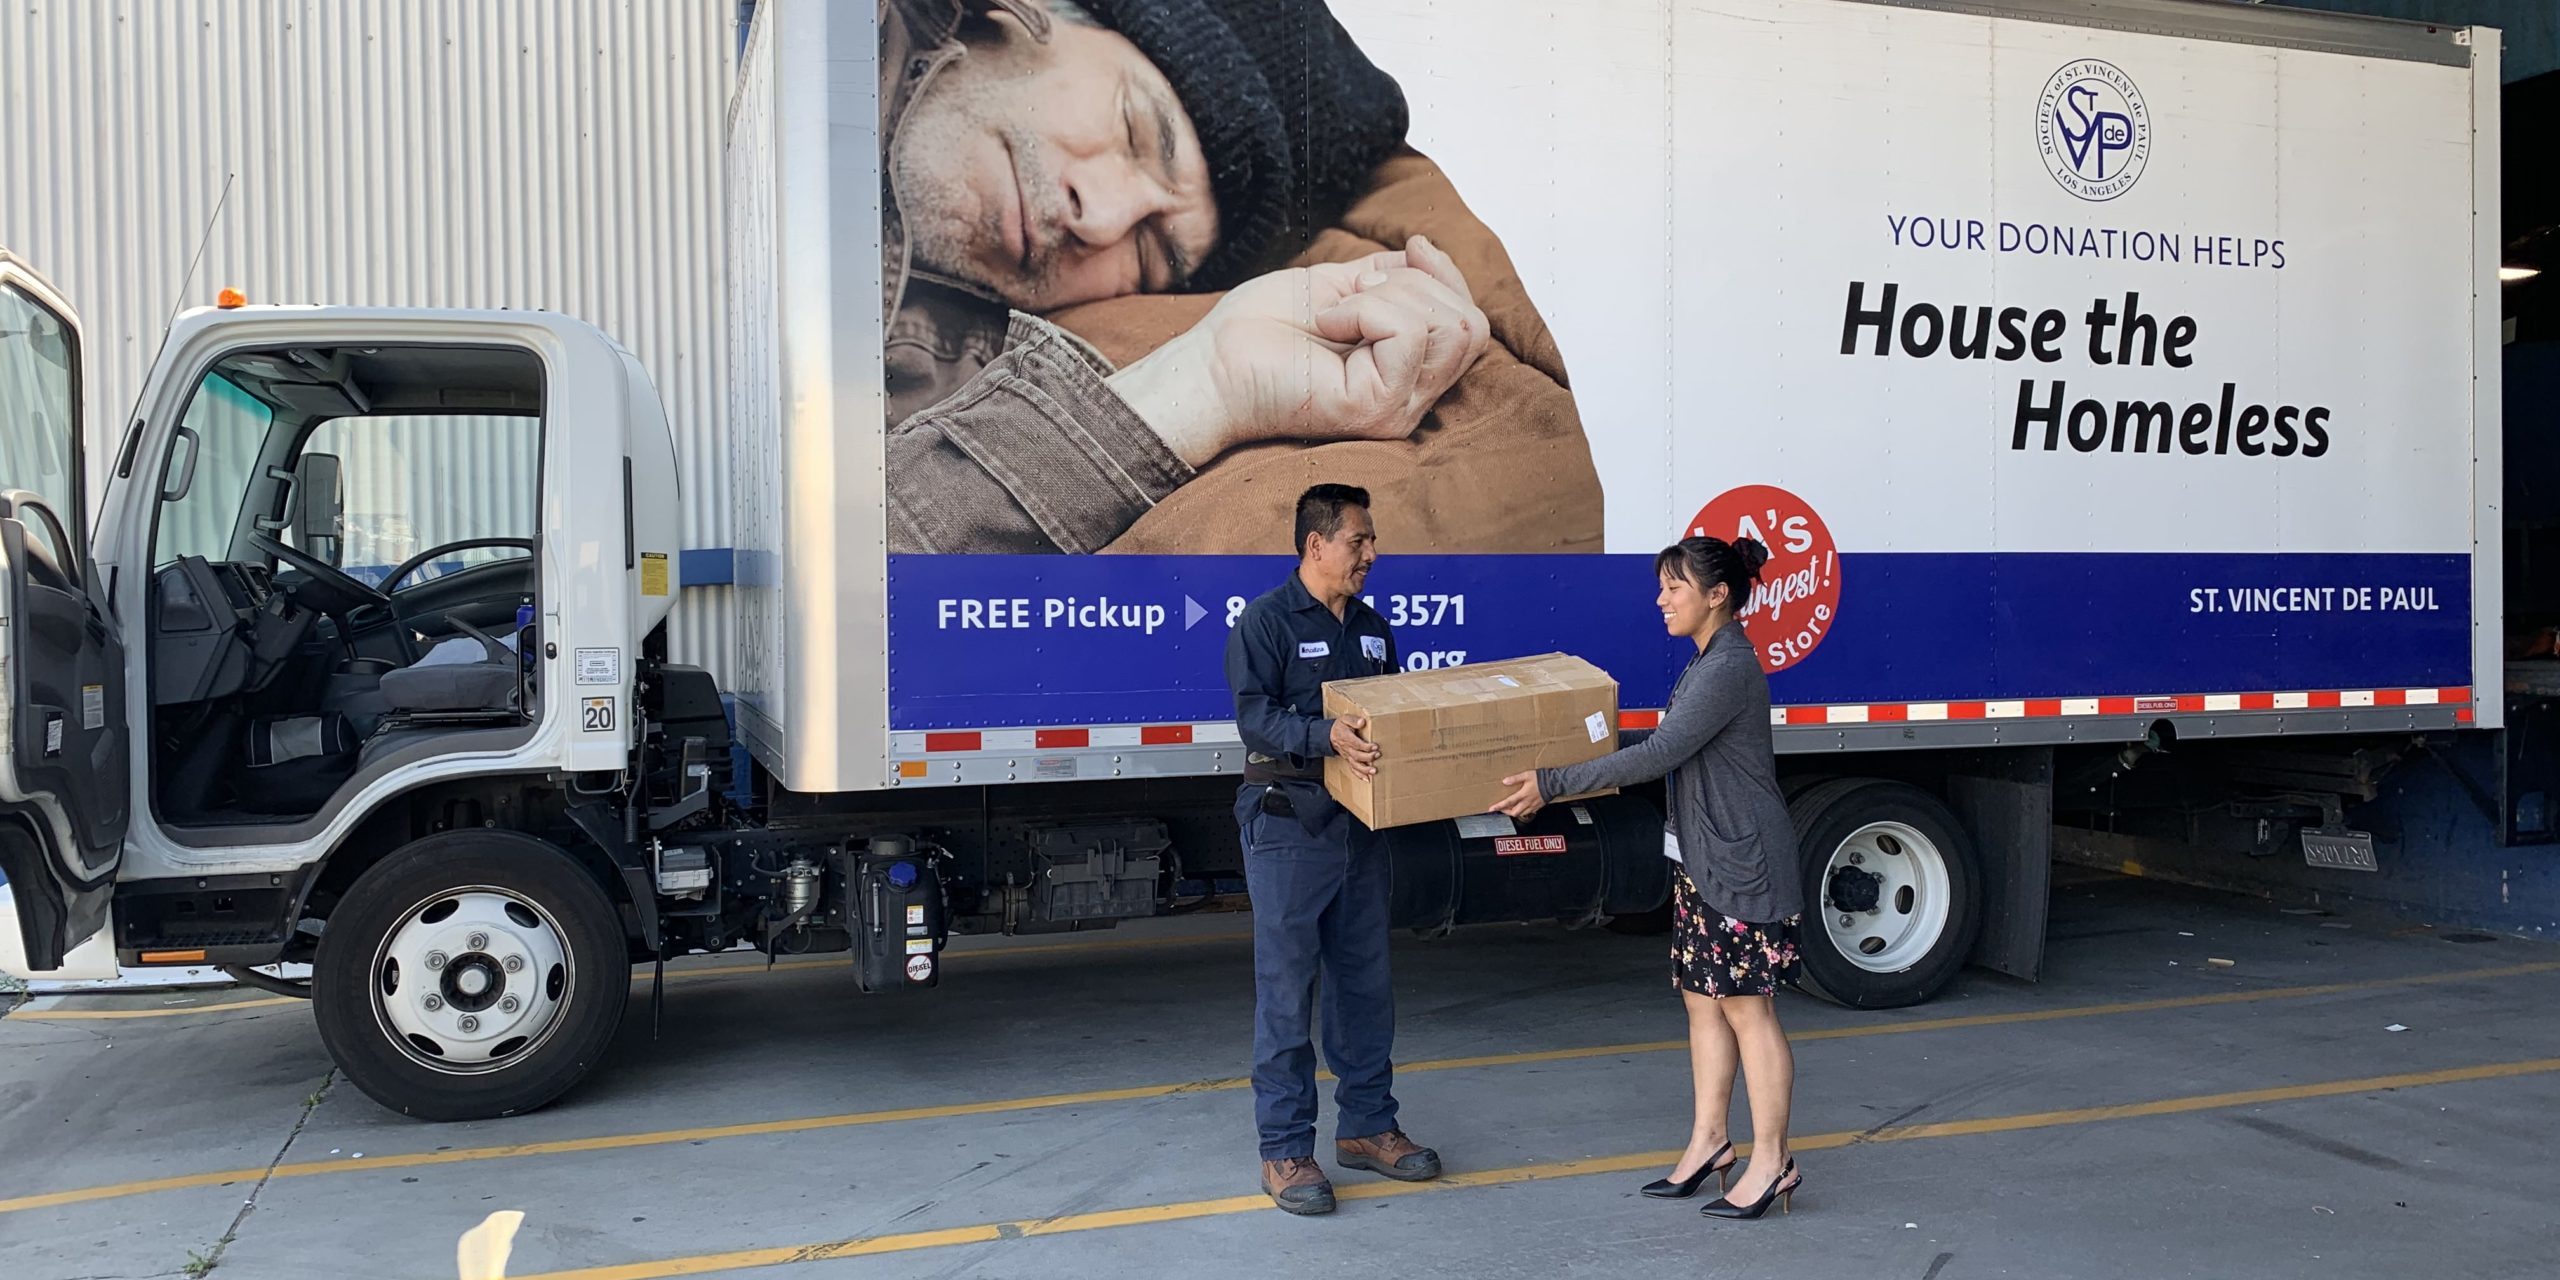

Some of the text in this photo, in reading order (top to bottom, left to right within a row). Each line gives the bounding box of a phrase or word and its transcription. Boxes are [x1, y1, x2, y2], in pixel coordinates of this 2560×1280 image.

[2040, 64, 2146, 162] SOCIETY of ST. VINCENT de PAUL
[2057, 168, 2132, 196] LOS ANGELES
[1887, 215, 2287, 269] YOUR DONATION HELPS
[1840, 281, 2198, 369] House the
[2011, 379, 2331, 458] Homeless
[1694, 509, 1813, 560] A's
[939, 598, 1030, 629] FREE
[1044, 596, 1165, 634] Pickup
[2190, 587, 2440, 613] ST. VINCENT DE PAUL
[1768, 603, 1831, 666] Store
[585, 706, 611, 729] 20
[1497, 837, 1562, 852] DIESEL FUEL ONLY
[908, 962, 931, 974] DIESEL
